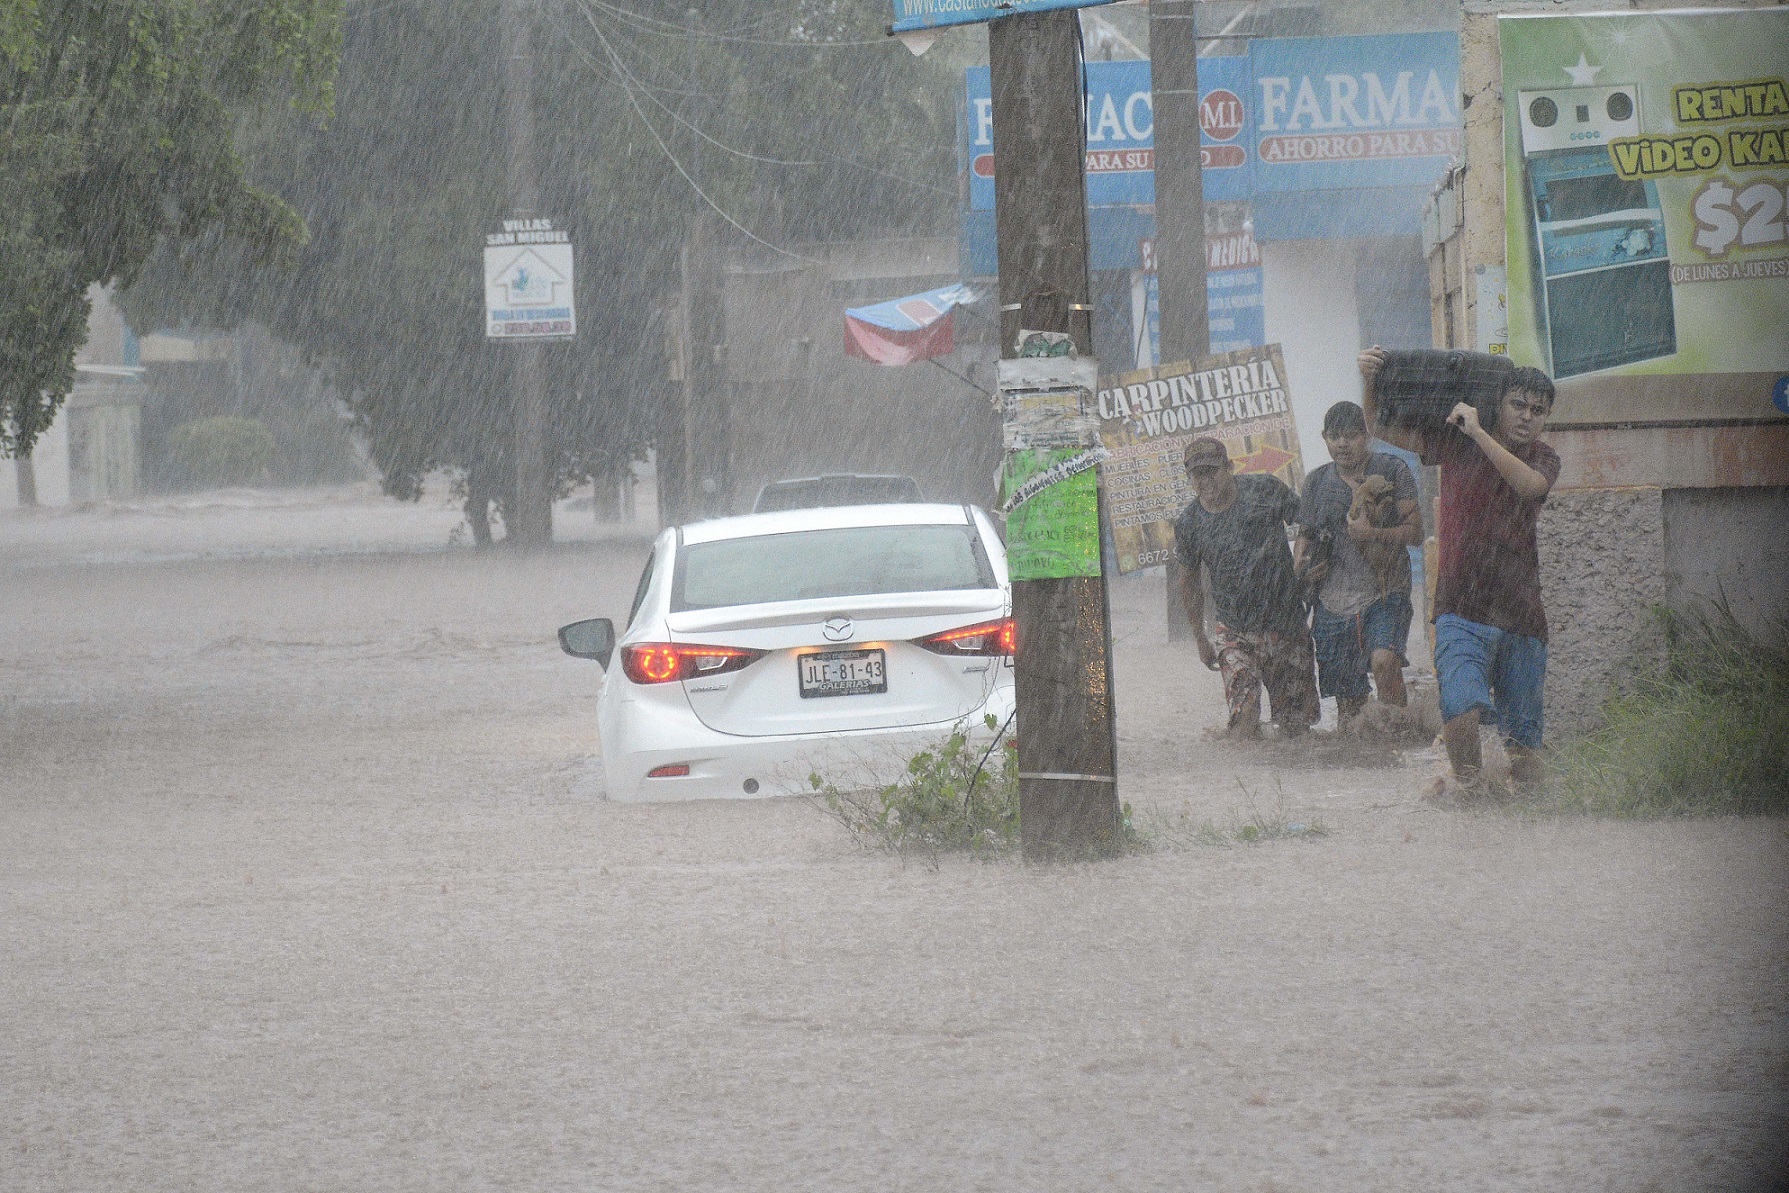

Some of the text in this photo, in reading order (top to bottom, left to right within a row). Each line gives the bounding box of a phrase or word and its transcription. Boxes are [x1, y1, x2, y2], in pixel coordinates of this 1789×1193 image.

[1258, 68, 1463, 131] FARMA
[1676, 80, 1789, 122] RENTA
[1266, 136, 1364, 161] AHORRO
[1369, 134, 1427, 156] PARA
[1086, 152, 1148, 170] ARA SU
[503, 219, 552, 232] VILLAS
[1694, 181, 1789, 254] $2
[487, 231, 568, 245] SAN MIGUEL
[1693, 263, 1729, 281] LUNES
[1732, 265, 1741, 278] A
[1744, 260, 1789, 278] JUEVES
[1099, 356, 1281, 420] CARPINTERÍA
[1143, 389, 1287, 437] WOODPECKER
[1110, 435, 1181, 459] ABRICACIÓN
[1105, 458, 1149, 474] MUEBLES
[1158, 452, 1184, 463] PUER
[1108, 466, 1185, 487] COCINAS CLOS
[1110, 479, 1190, 501] PINTURA EN GEN
[1113, 491, 1198, 514] RESTAURACIONES
[1115, 512, 1163, 527] PINTAMOS
[1138, 549, 1169, 565] 6672
[805, 661, 882, 684] JLE-81-43
[819, 679, 870, 690] GALERIAS
